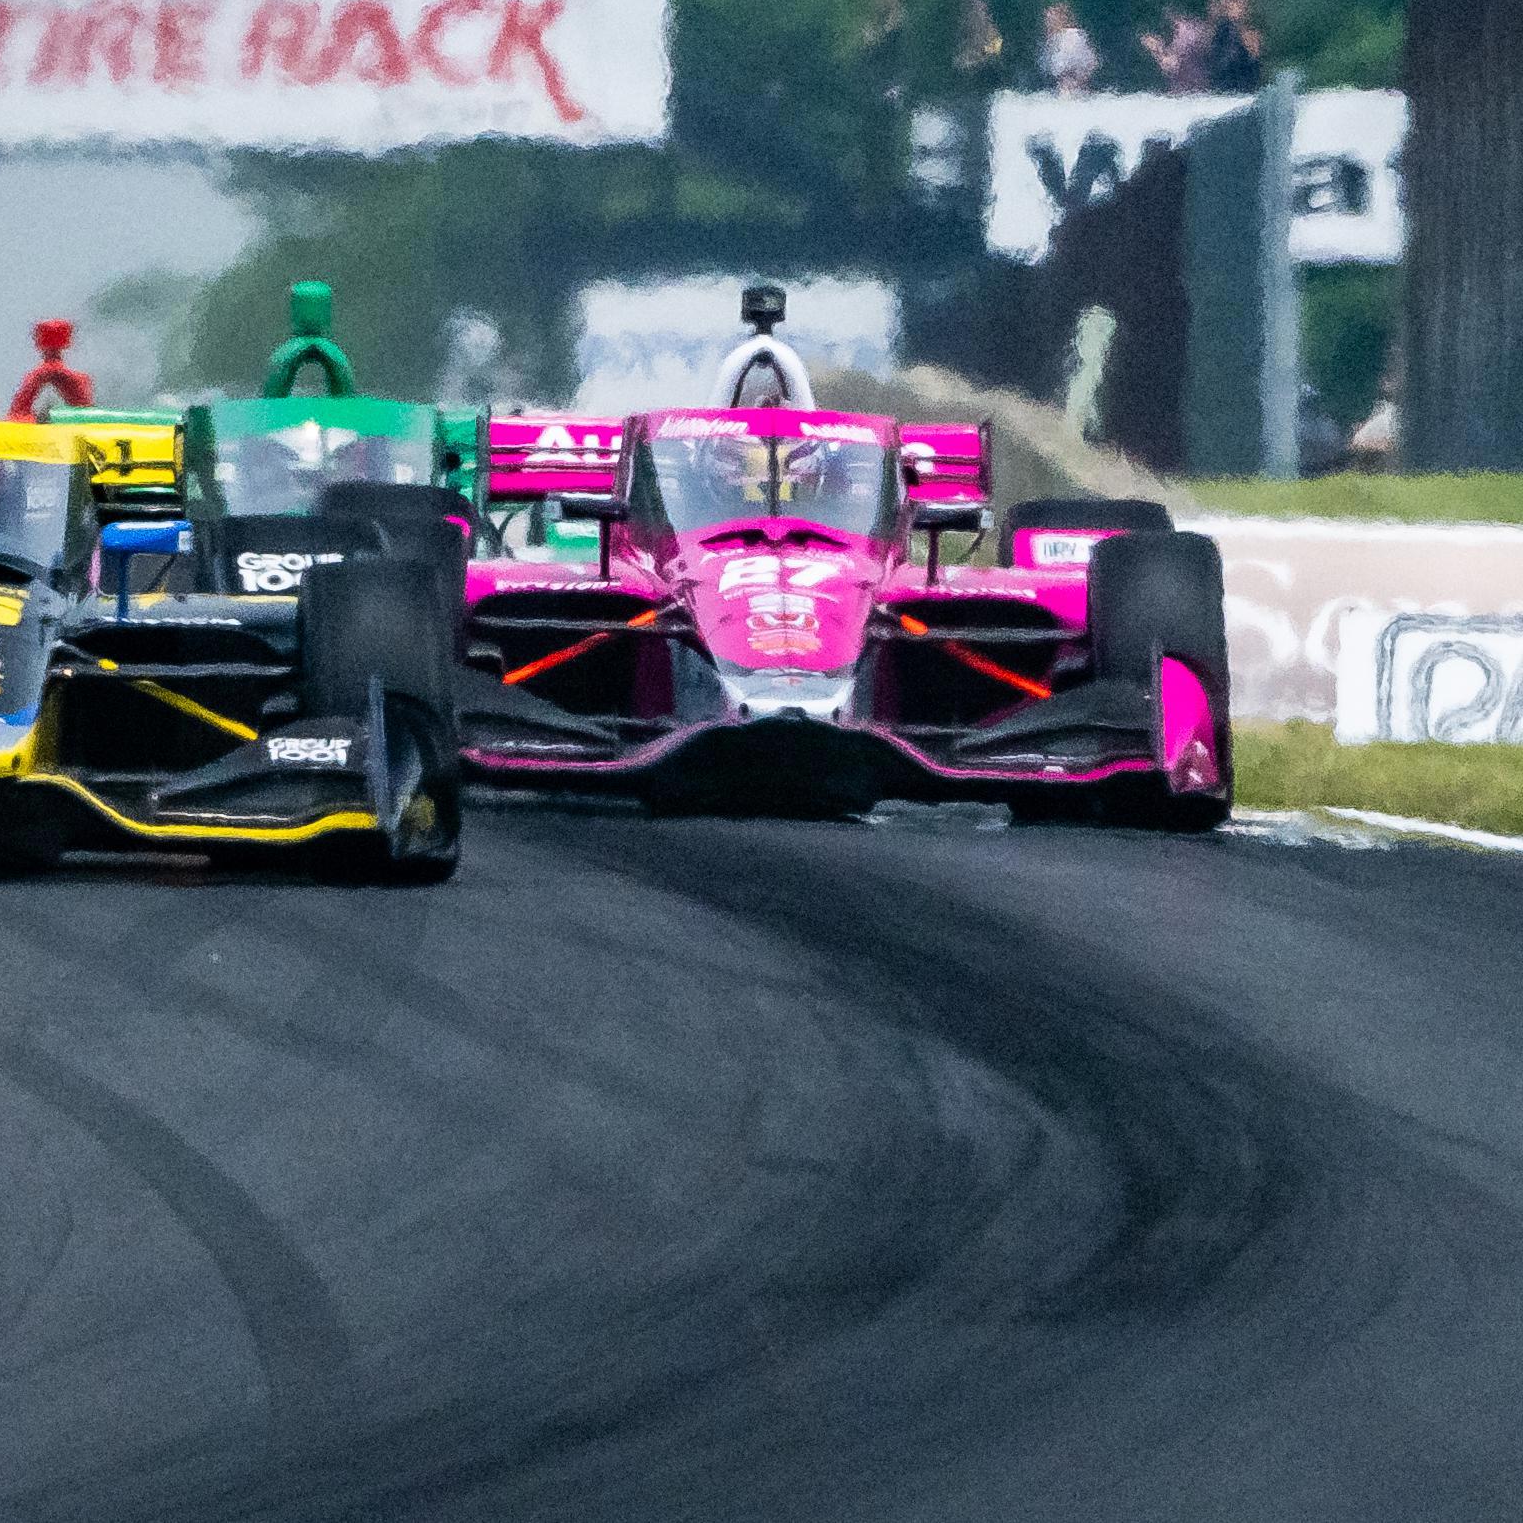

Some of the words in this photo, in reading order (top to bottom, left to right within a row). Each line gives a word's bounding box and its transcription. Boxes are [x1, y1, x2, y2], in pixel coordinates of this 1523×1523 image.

[525, 423, 621, 463] Au
[718, 555, 839, 593] 27
[267, 738, 352, 750] GROUP
[269, 748, 348, 763] 1001
